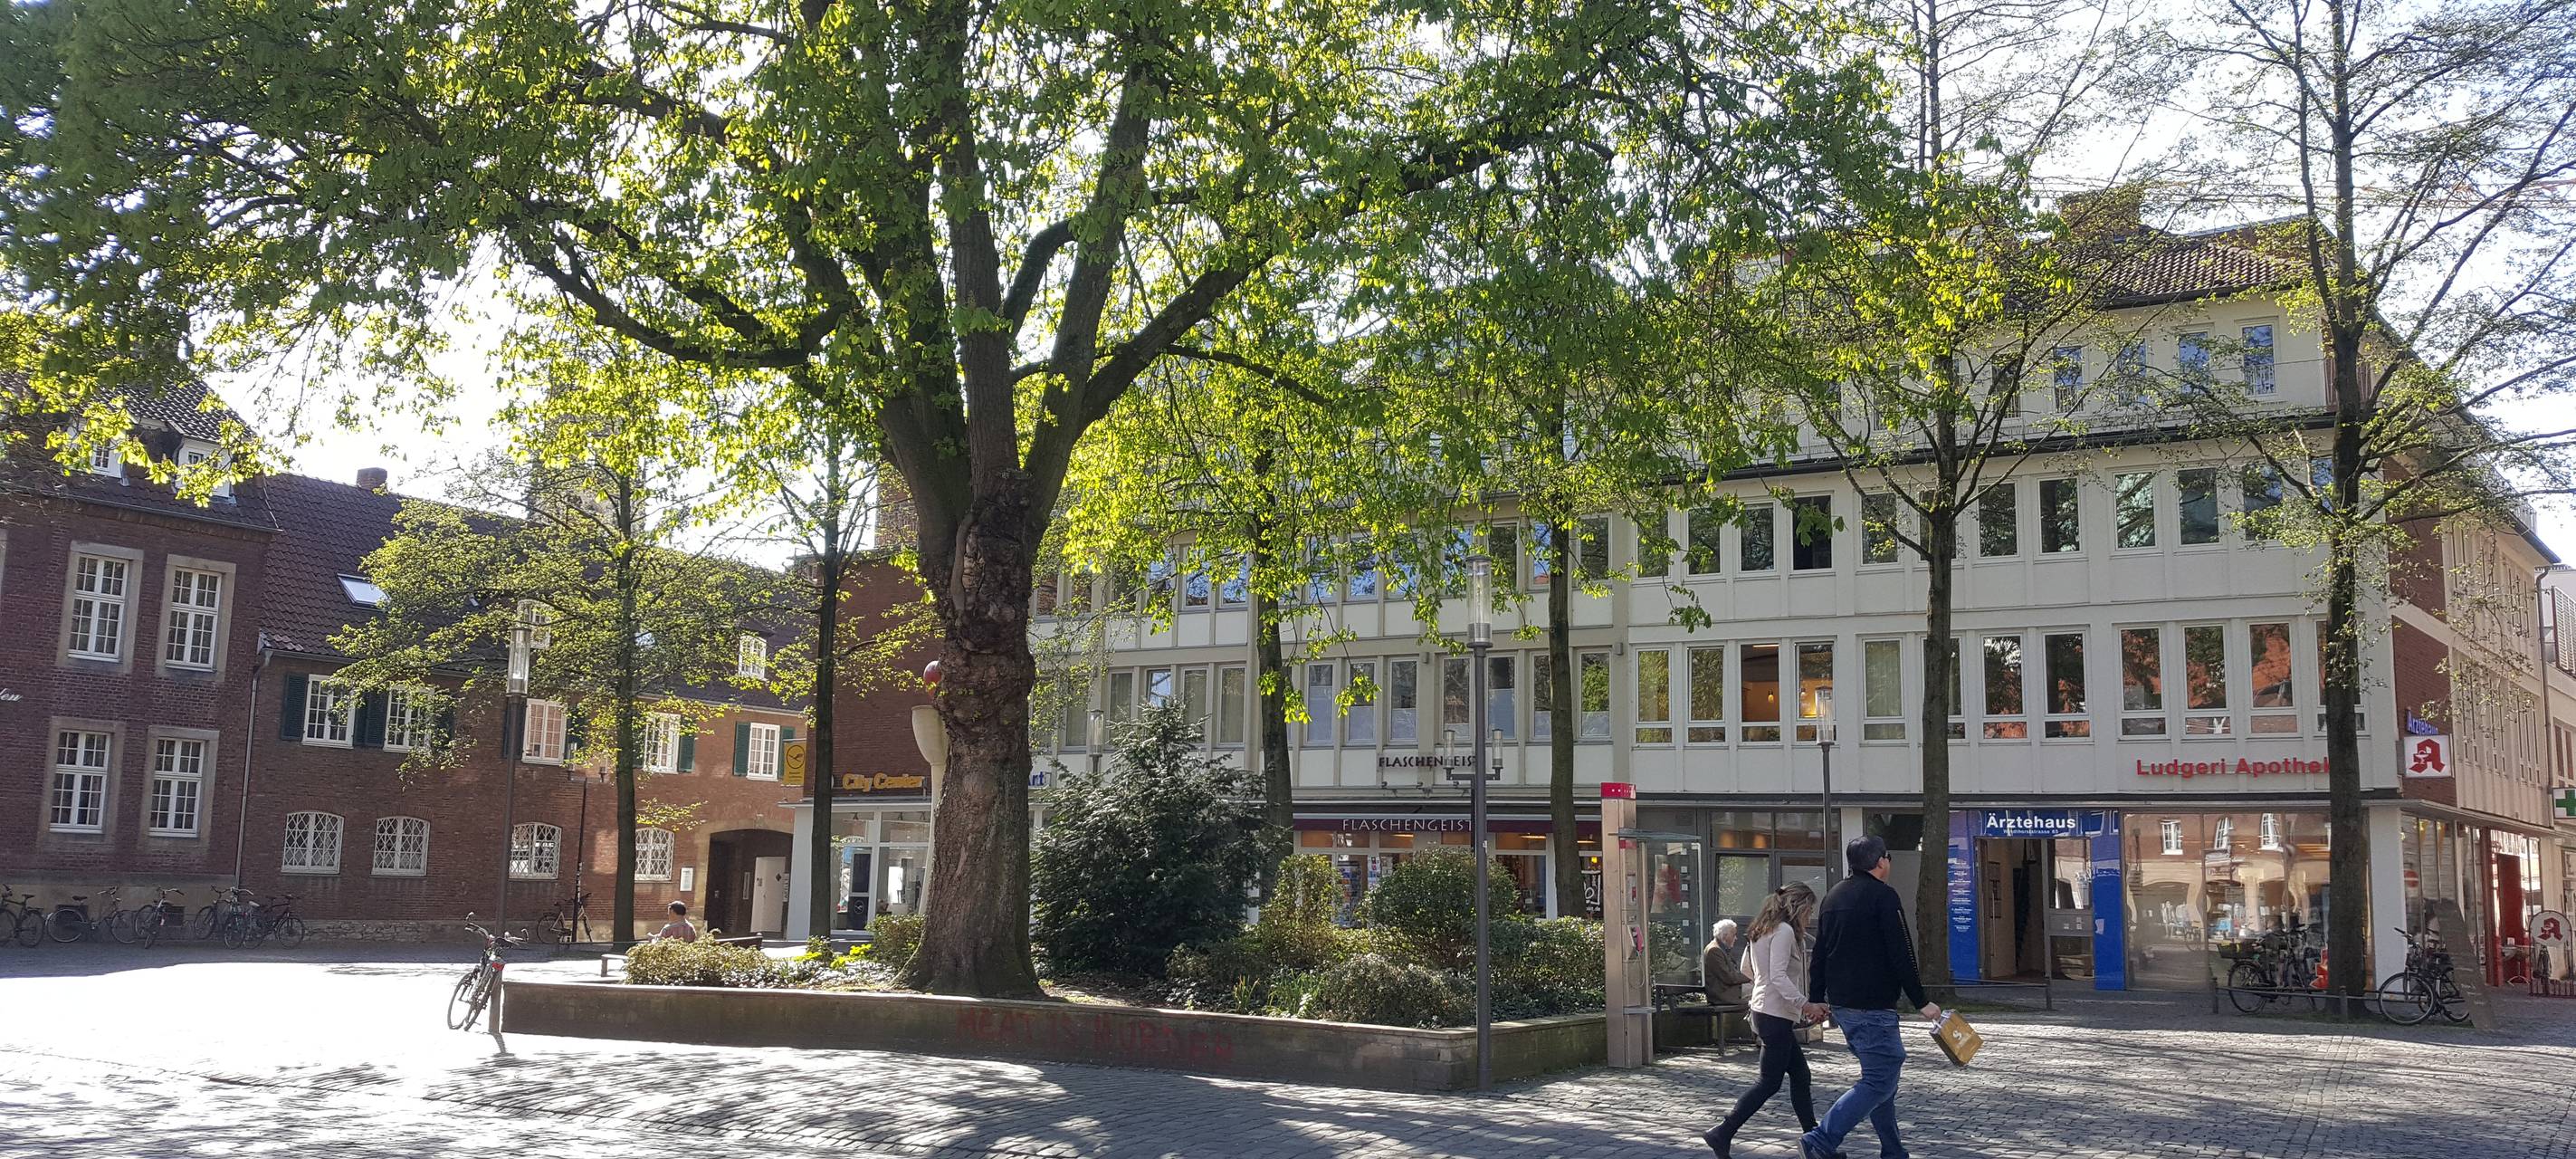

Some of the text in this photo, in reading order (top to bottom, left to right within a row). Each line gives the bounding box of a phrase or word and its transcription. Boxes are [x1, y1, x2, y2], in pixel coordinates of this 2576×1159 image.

[2136, 758, 2226, 779] Ludgeri
[843, 772, 926, 792] City Center
[1987, 813, 2075, 829] Ärztehaus
